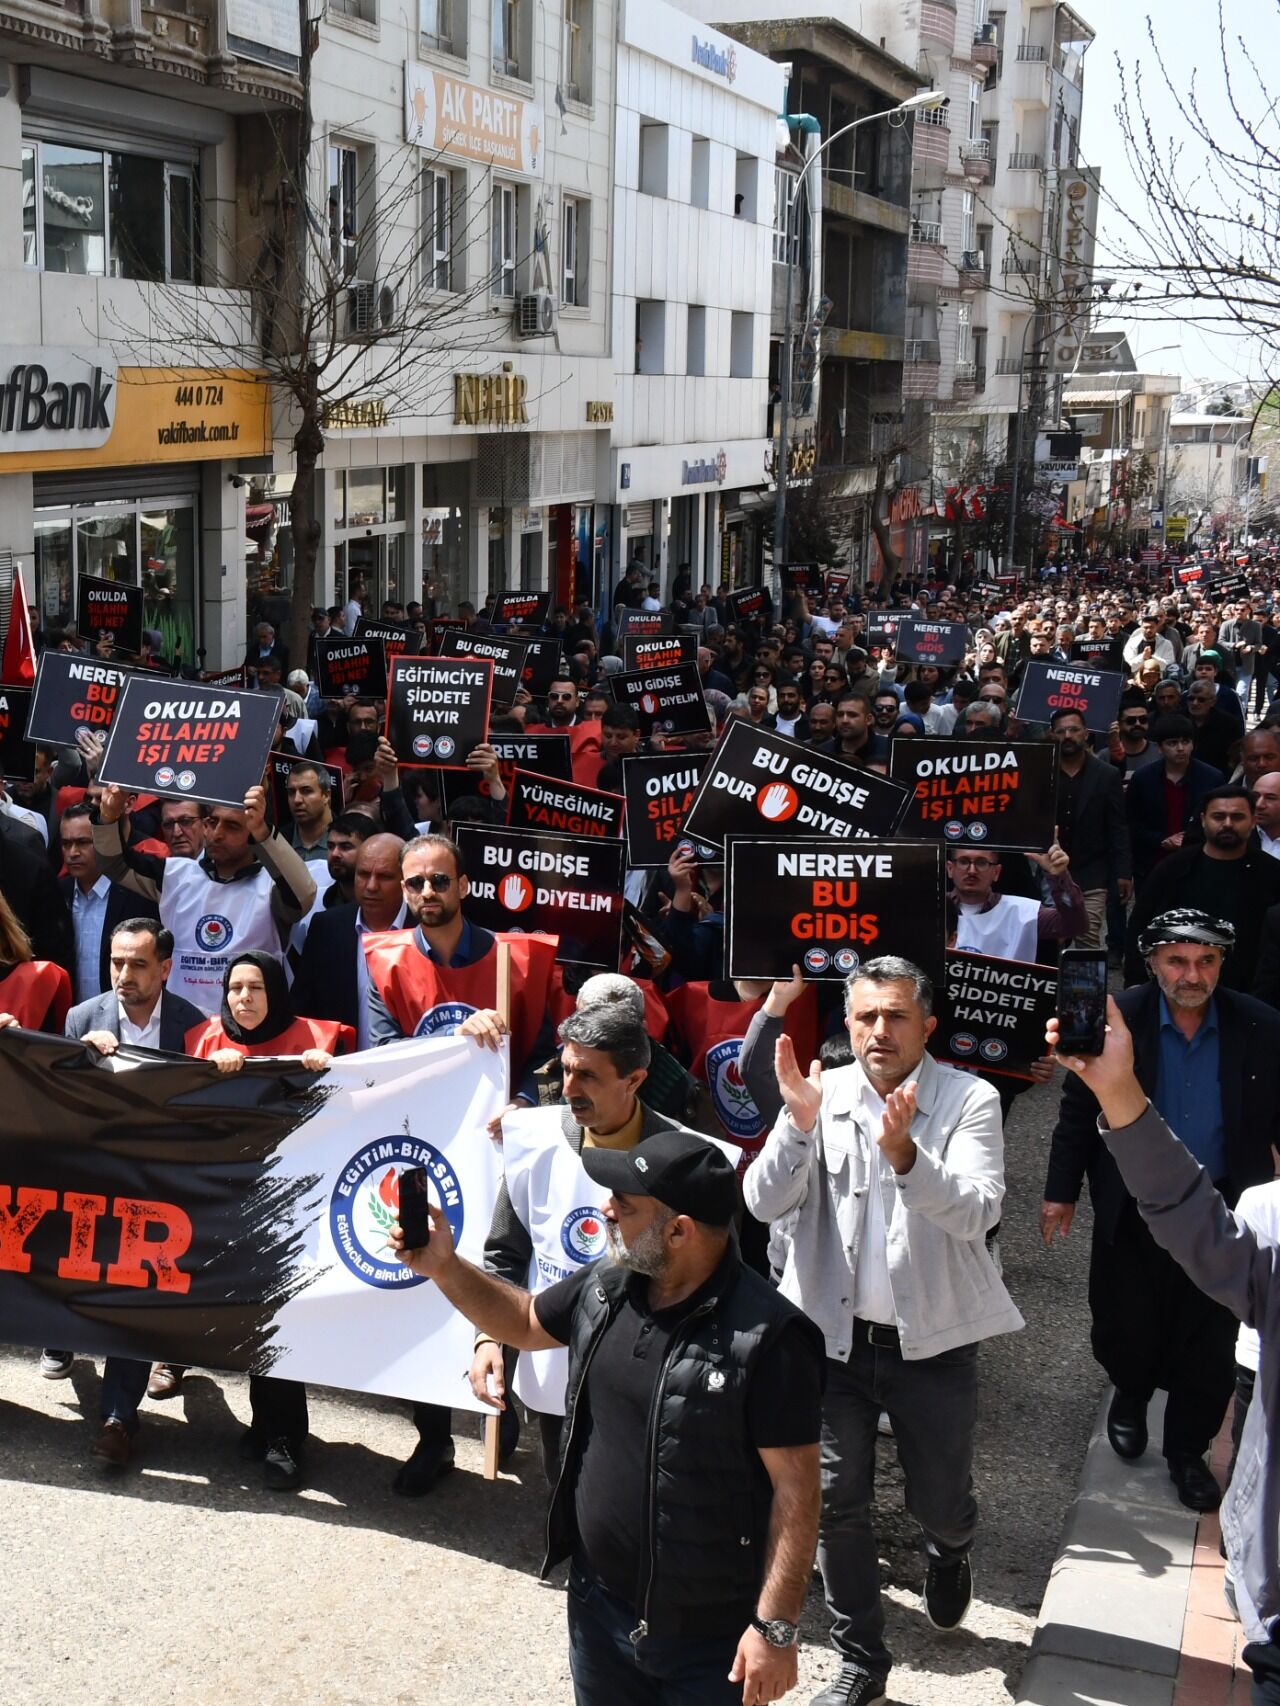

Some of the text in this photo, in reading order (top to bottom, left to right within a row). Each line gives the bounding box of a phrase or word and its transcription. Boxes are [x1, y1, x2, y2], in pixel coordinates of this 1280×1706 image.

[442, 82, 517, 139] AK PARTİ
[175, 385, 223, 407] 444 0 724
[453, 361, 529, 425] NEHİR
[88, 591, 128, 602] OKULDA
[503, 595, 539, 605] OKULDA
[628, 615, 662, 623] OKULDA
[914, 623, 952, 634] NEREYE
[365, 630, 406, 641] OKULDA
[923, 634, 938, 642] BU
[327, 644, 368, 661] OKULDA
[456, 640, 510, 660] BU GİDİŞE
[635, 649, 682, 662] SİLAHIN
[636, 640, 680, 653] OKULDA
[1080, 644, 1110, 652] NEREYE
[69, 663, 126, 688] NEREY
[397, 667, 485, 686] EĞİTİMCİYE
[627, 675, 682, 694] BU GİDİŞE
[1046, 668, 1102, 686] NEREYE
[86, 684, 117, 704] BU
[407, 686, 471, 705] ŞİDDETE
[660, 692, 699, 707] DİYELİM
[1059, 683, 1083, 696] BU
[70, 703, 114, 724] GİDİ
[144, 701, 241, 720] OKULDA
[413, 709, 460, 725] HAYIR
[136, 722, 239, 741] SİLAHIN
[137, 744, 225, 766] İŞİ NE?
[494, 744, 538, 760] REYE
[917, 750, 1018, 777] OKULDA
[646, 767, 700, 797] OKUL
[712, 771, 757, 802] DUR
[752, 747, 870, 810] BU GİDİŞE
[915, 772, 1019, 800] SİLAHIN
[520, 785, 615, 821] YÜREĞİMİZ
[647, 791, 694, 819] SİLA
[921, 794, 1010, 821] İŞİ NE?
[483, 846, 590, 877] BU GİDİŞE
[777, 855, 893, 879] NEREYE
[537, 887, 612, 913] DİYELİM
[812, 881, 858, 907] BU
[791, 912, 878, 945] GİDİŞ
[948, 983, 1037, 1012] ŞİDDETE
[954, 1005, 1018, 1029] HAYIR
[338, 1142, 460, 1208] EĞİTİM-BİR-SEN
[336, 1214, 414, 1282] EĞİTİMCİLER BİRLİĞİ
